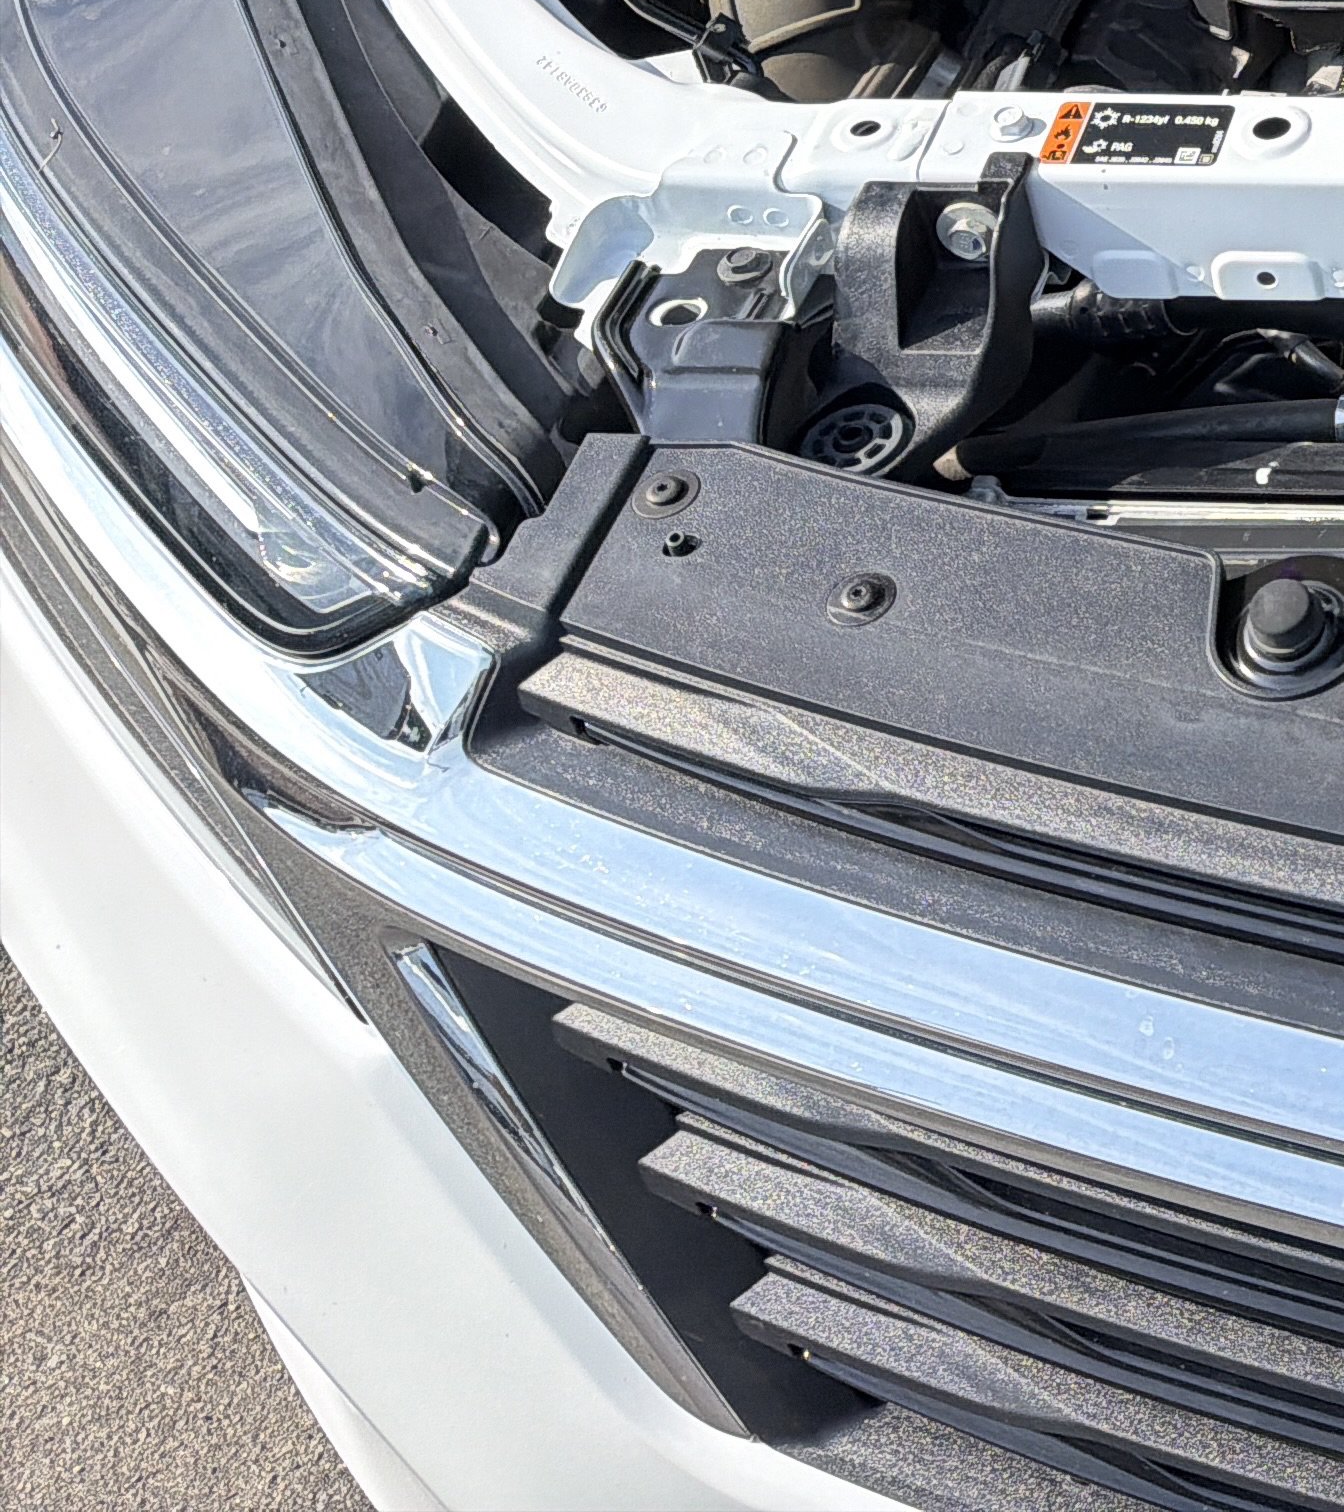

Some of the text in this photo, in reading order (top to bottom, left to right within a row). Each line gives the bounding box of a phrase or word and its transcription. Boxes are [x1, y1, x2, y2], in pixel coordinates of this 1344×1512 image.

[1121, 114, 1170, 126] R-1234yf
[1204, 115, 1220, 128] kg
[1110, 141, 1134, 152] PAG
